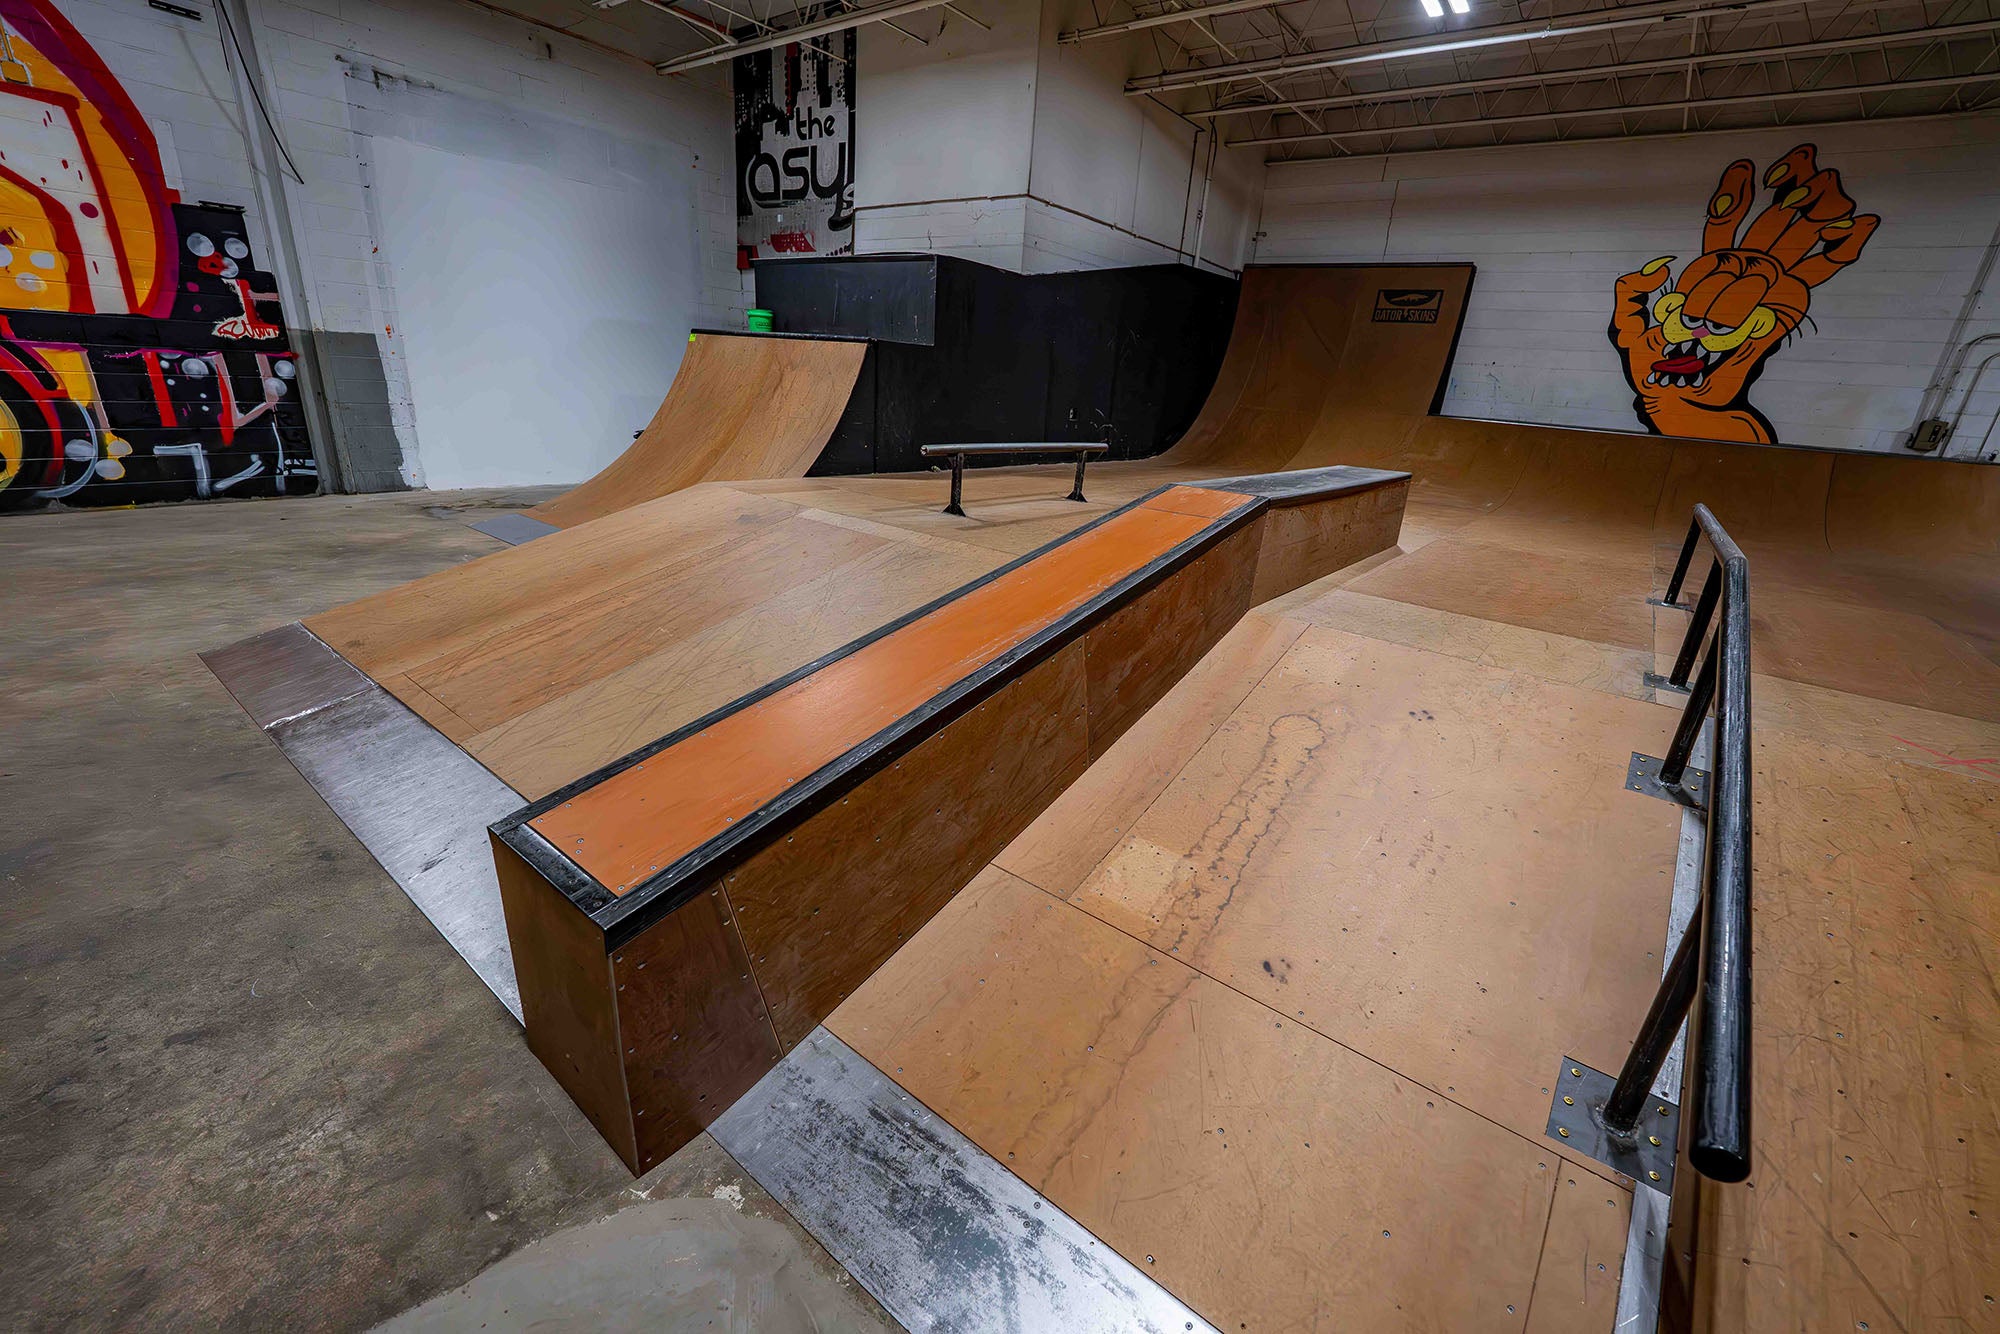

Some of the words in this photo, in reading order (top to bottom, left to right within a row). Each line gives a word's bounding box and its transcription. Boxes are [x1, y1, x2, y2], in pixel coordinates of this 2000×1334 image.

[795, 106, 836, 140] the
[1373, 309, 1403, 321] GATOR
[1407, 310, 1436, 322] SKINS
